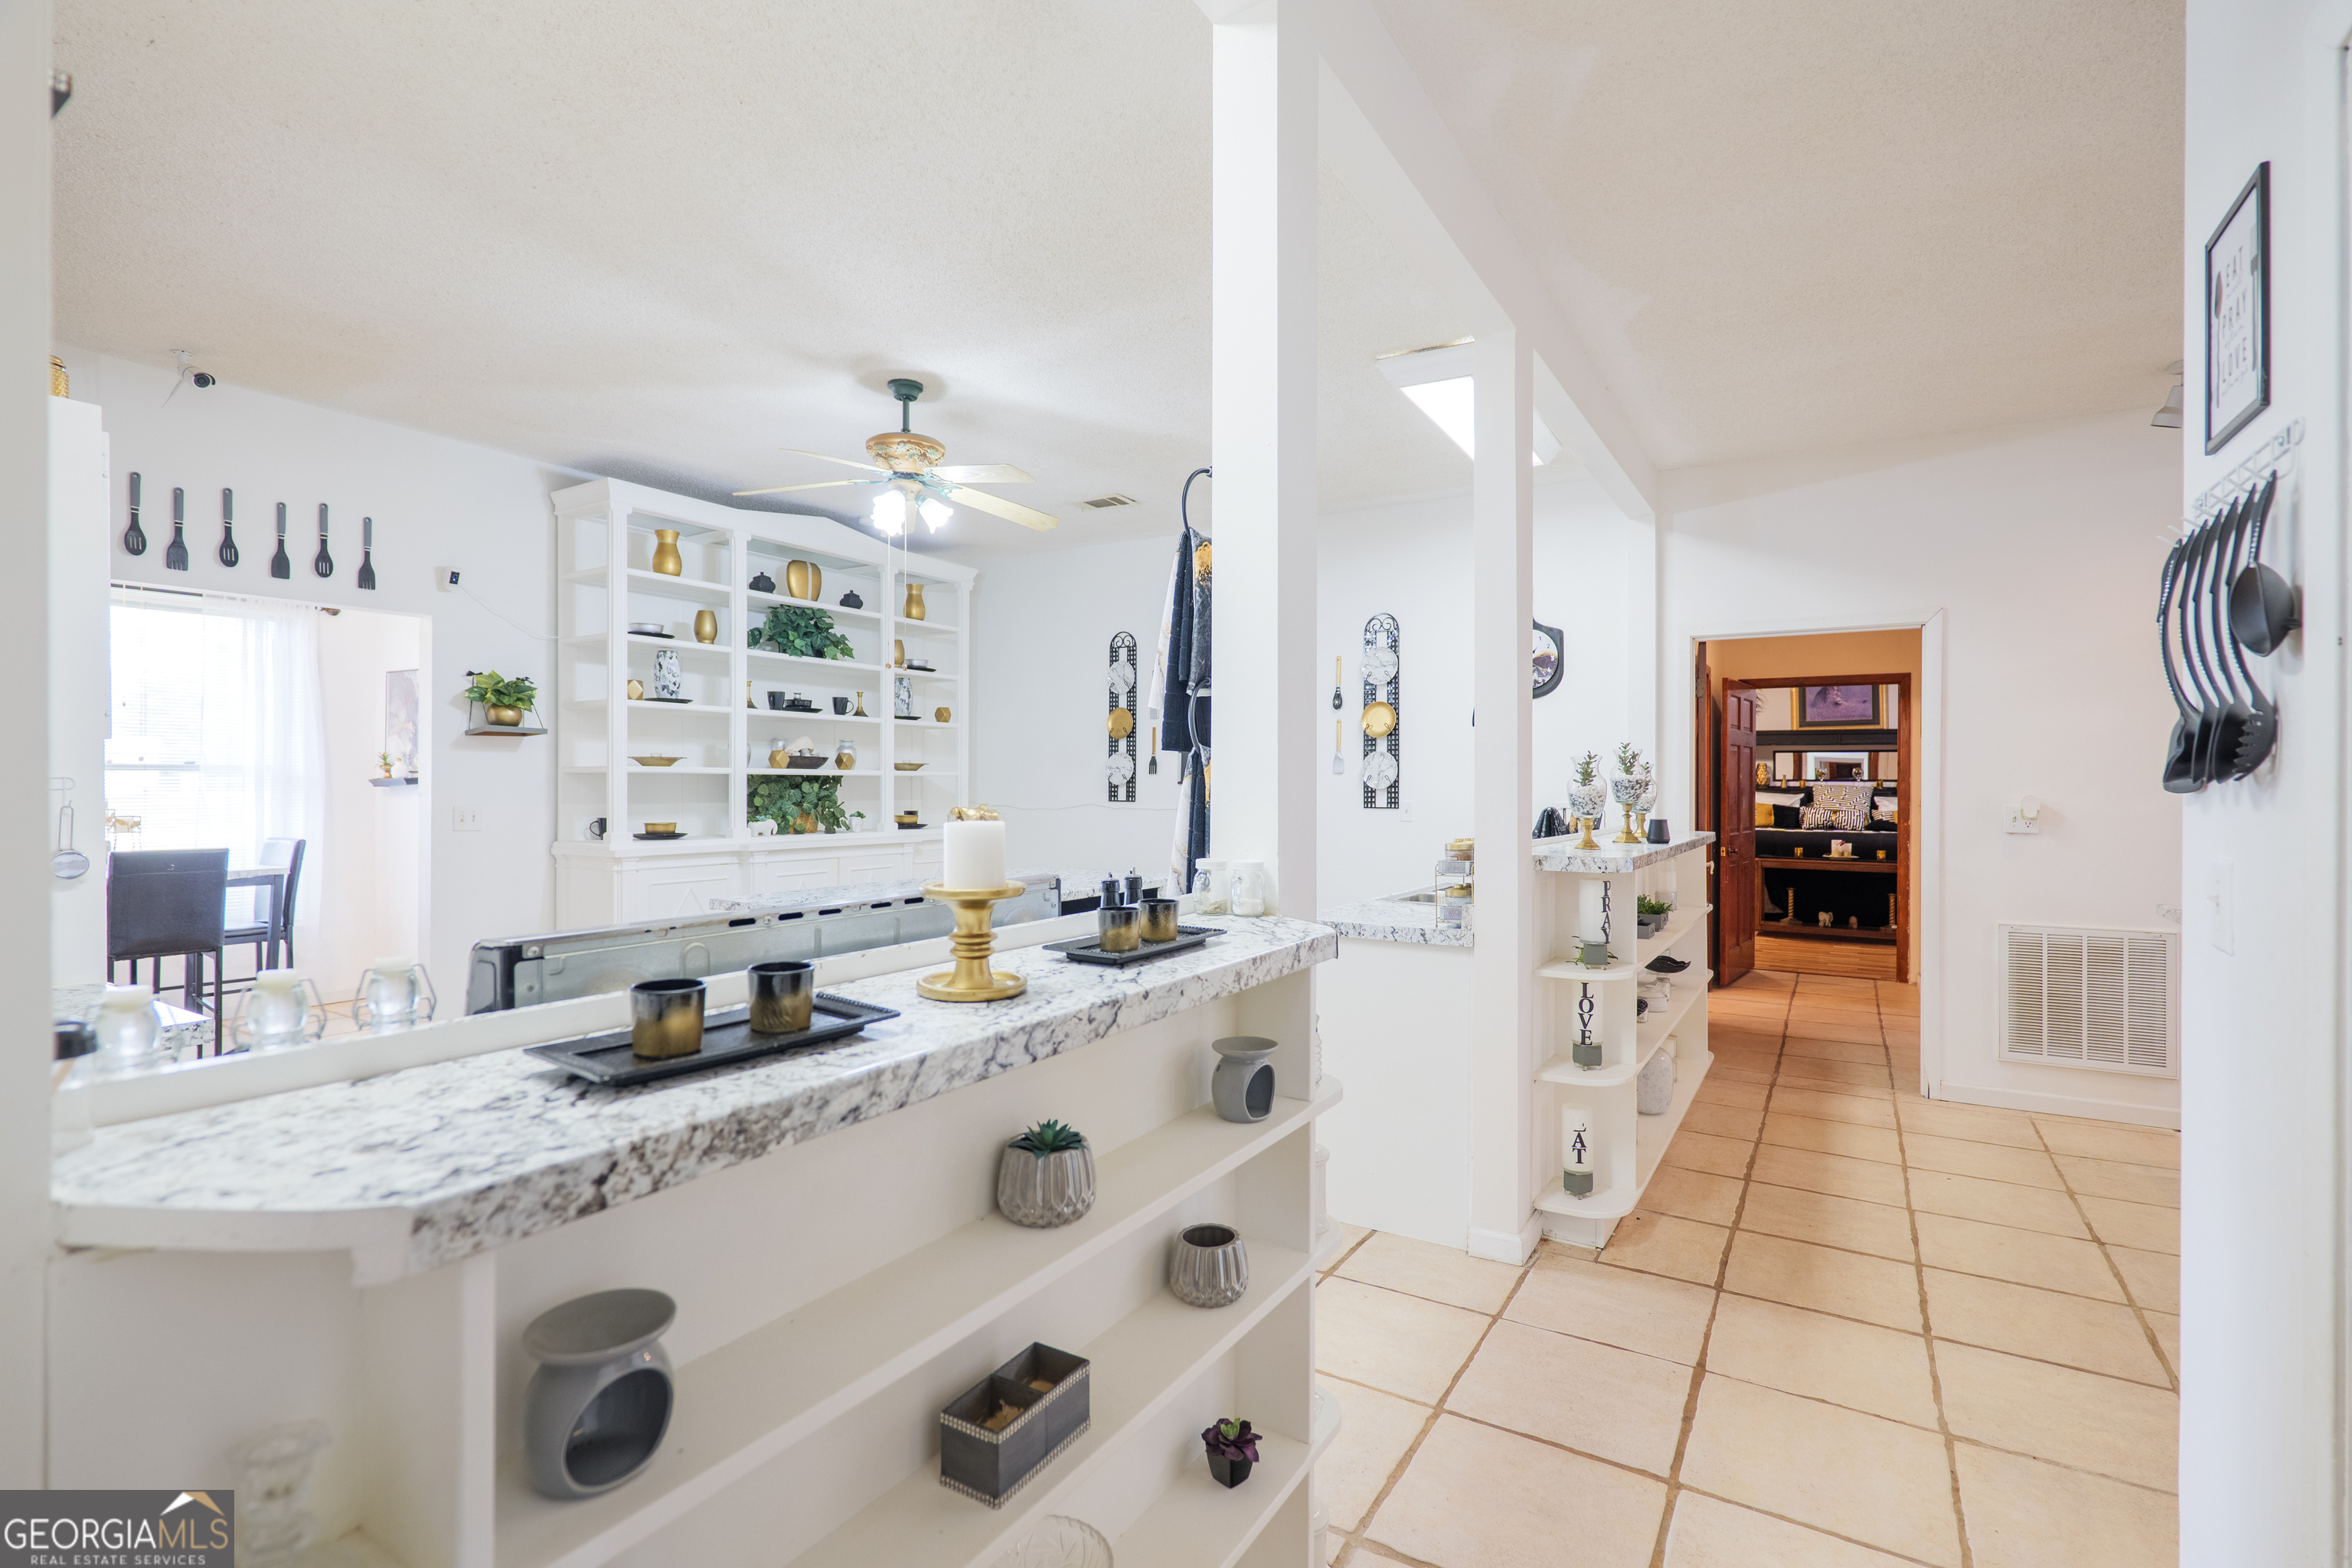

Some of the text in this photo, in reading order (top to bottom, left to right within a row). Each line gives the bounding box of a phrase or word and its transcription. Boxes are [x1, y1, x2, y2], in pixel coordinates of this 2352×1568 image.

[2226, 245, 2243, 287] EAT
[2222, 287, 2247, 338] PRAY
[2222, 336, 2247, 384] LOVE
[1600, 880, 1612, 945] PRAY
[1577, 982, 1595, 1046] LOVE
